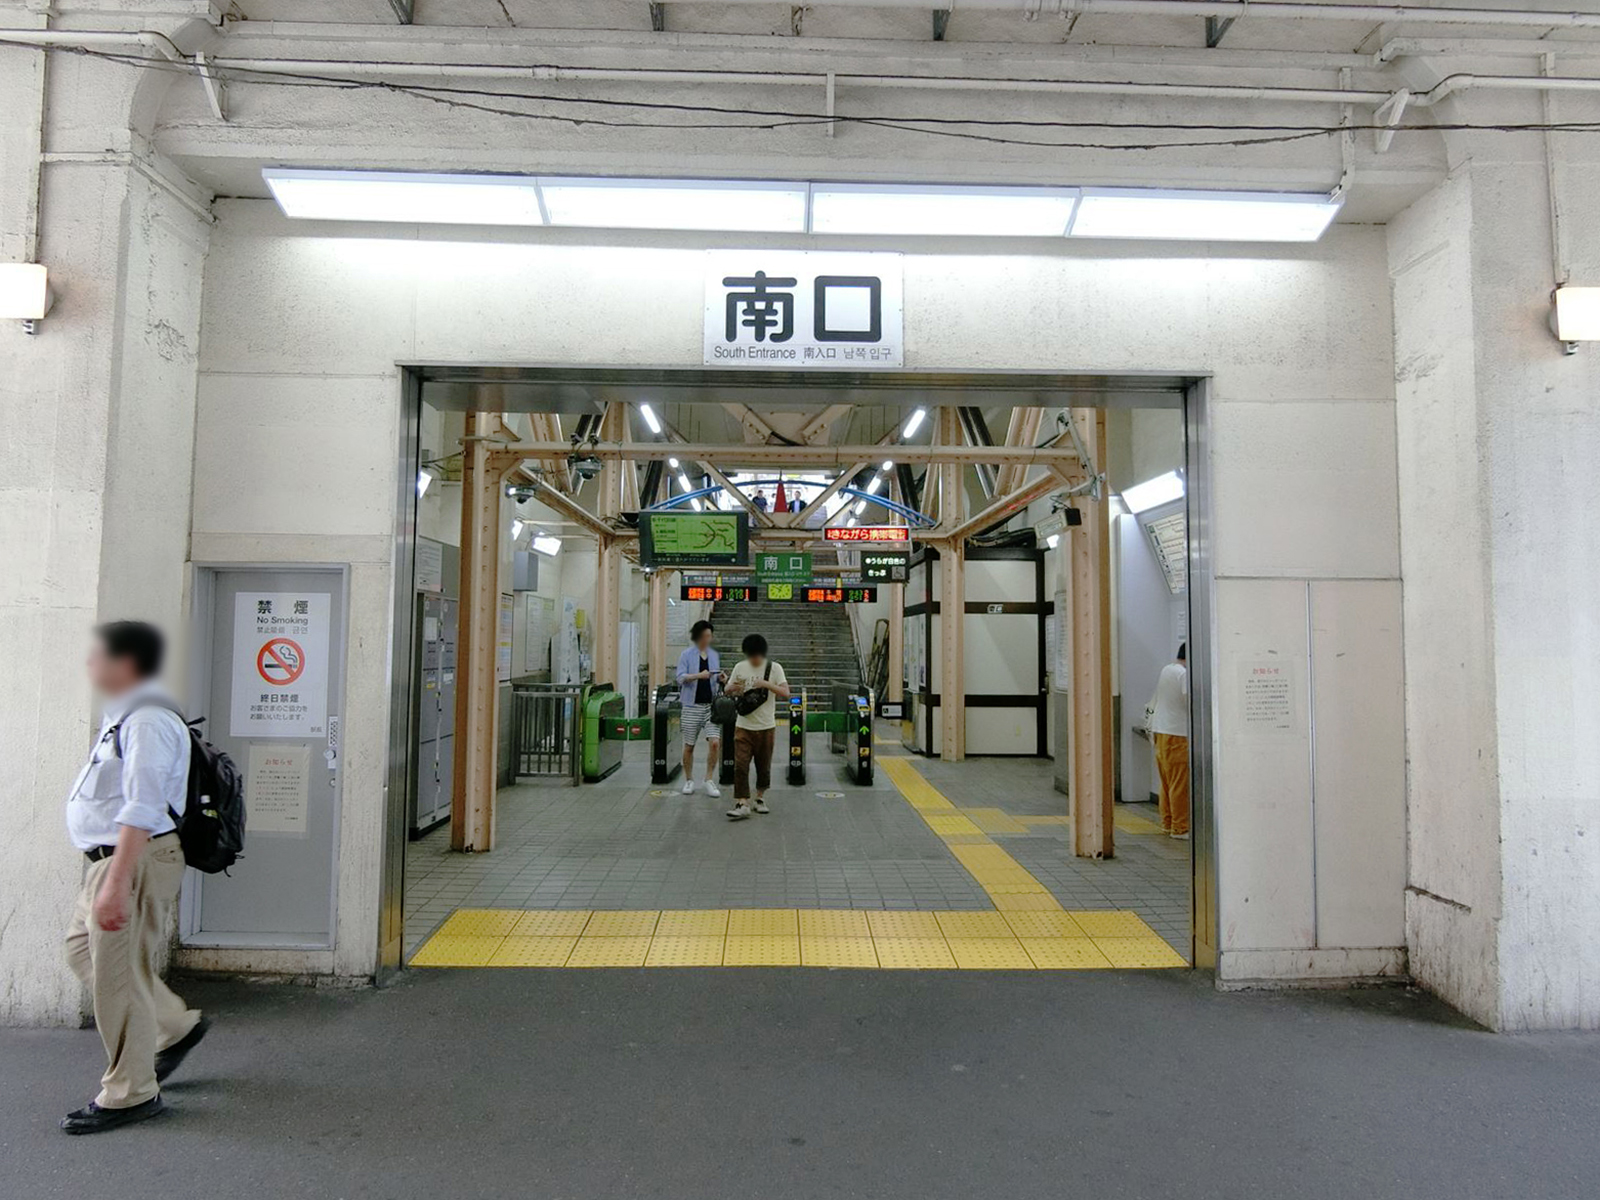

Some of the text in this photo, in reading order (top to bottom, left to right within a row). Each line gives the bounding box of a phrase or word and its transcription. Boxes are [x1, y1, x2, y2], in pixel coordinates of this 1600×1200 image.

[722, 270, 882, 343] 南口
[714, 346, 797, 359] South Entrance
[804, 347, 837, 359] 南入口
[843, 347, 892, 360] 남쪽 입구
[763, 556, 803, 570] 南口
[257, 600, 309, 614] 禁煙
[257, 616, 309, 626] No Smoking
[261, 694, 299, 703] 終日禁煙
